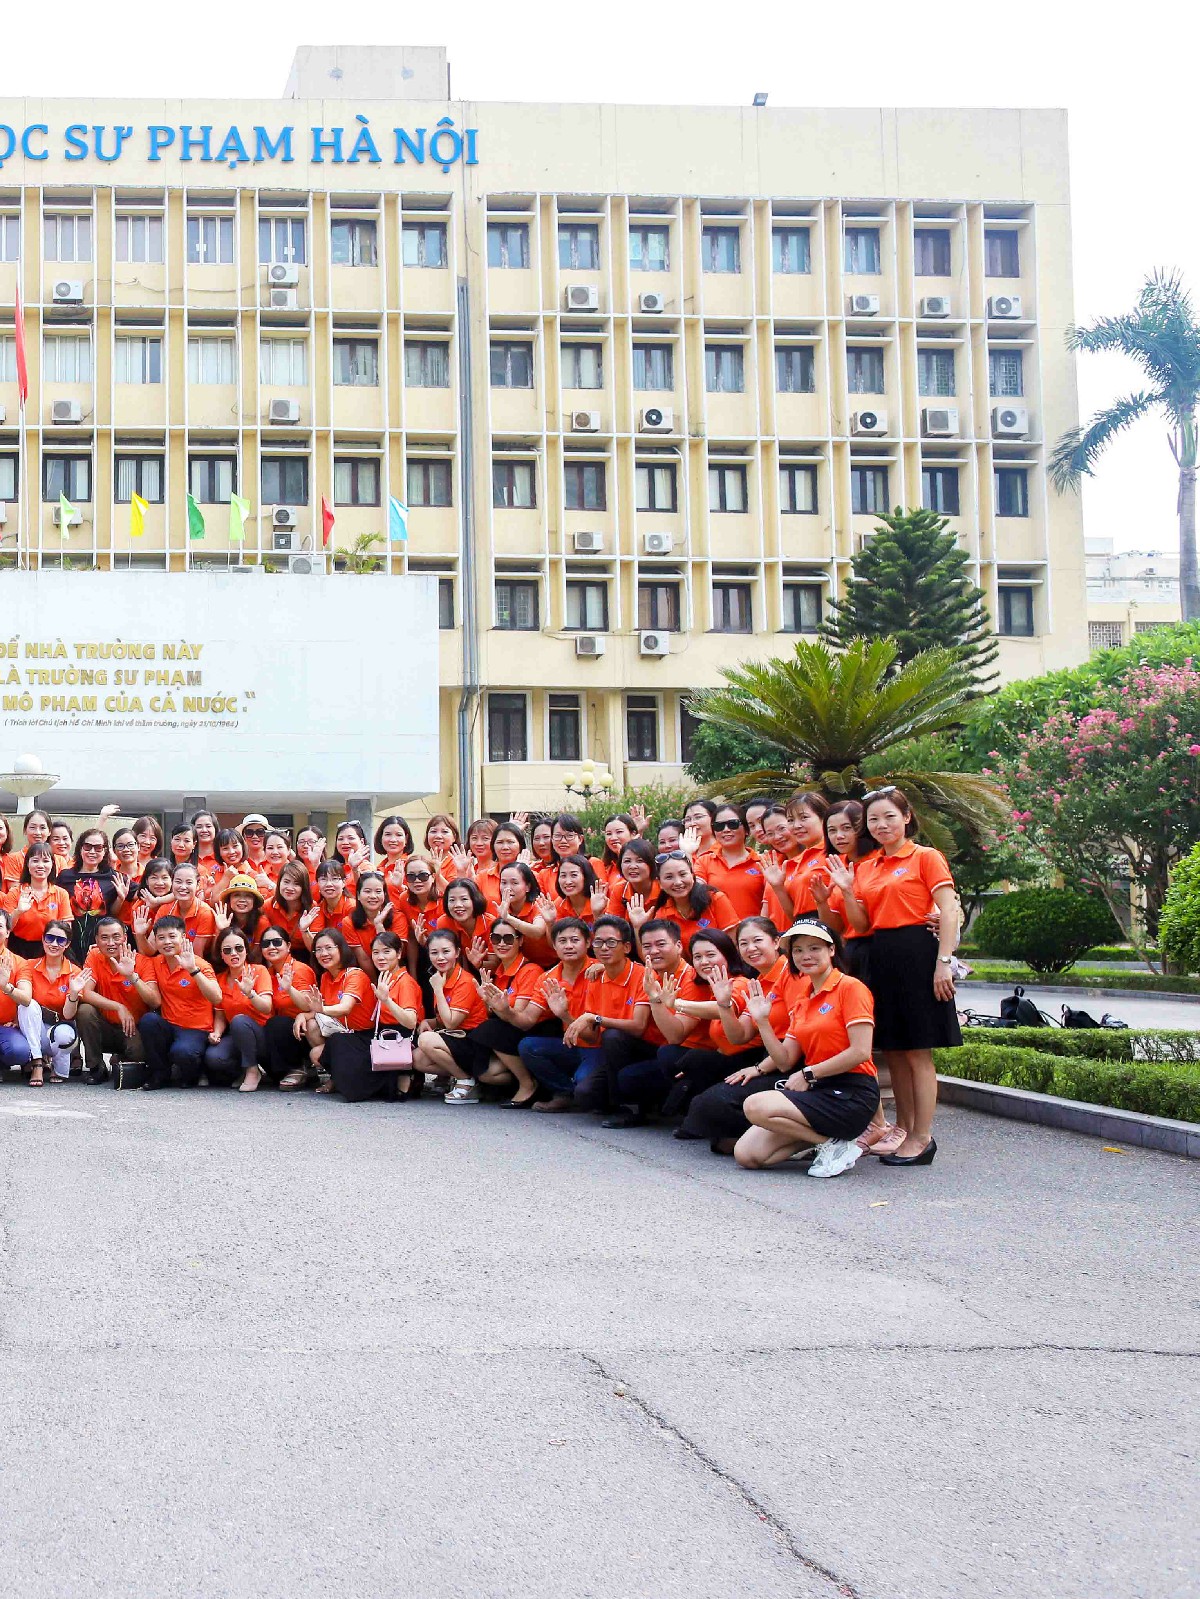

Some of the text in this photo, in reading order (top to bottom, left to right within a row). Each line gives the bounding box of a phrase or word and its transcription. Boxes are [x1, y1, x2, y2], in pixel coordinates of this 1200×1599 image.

[65, 125, 133, 161] SƯ
[149, 126, 295, 168] PHẠM
[312, 115, 383, 163] HÀ
[394, 117, 479, 172] NỘI
[25, 637, 68, 659] NHÀ
[74, 638, 156, 660] TRƯỜNG
[163, 639, 204, 660] NÀY
[26, 664, 108, 685] TRƯỜNG
[114, 669, 139, 685] SƯ
[145, 669, 202, 691] PHẠM
[3, 690, 34, 711] MÔ
[41, 696, 98, 717] PHẠM
[105, 690, 144, 713] CỦA
[150, 690, 177, 713] CẢ
